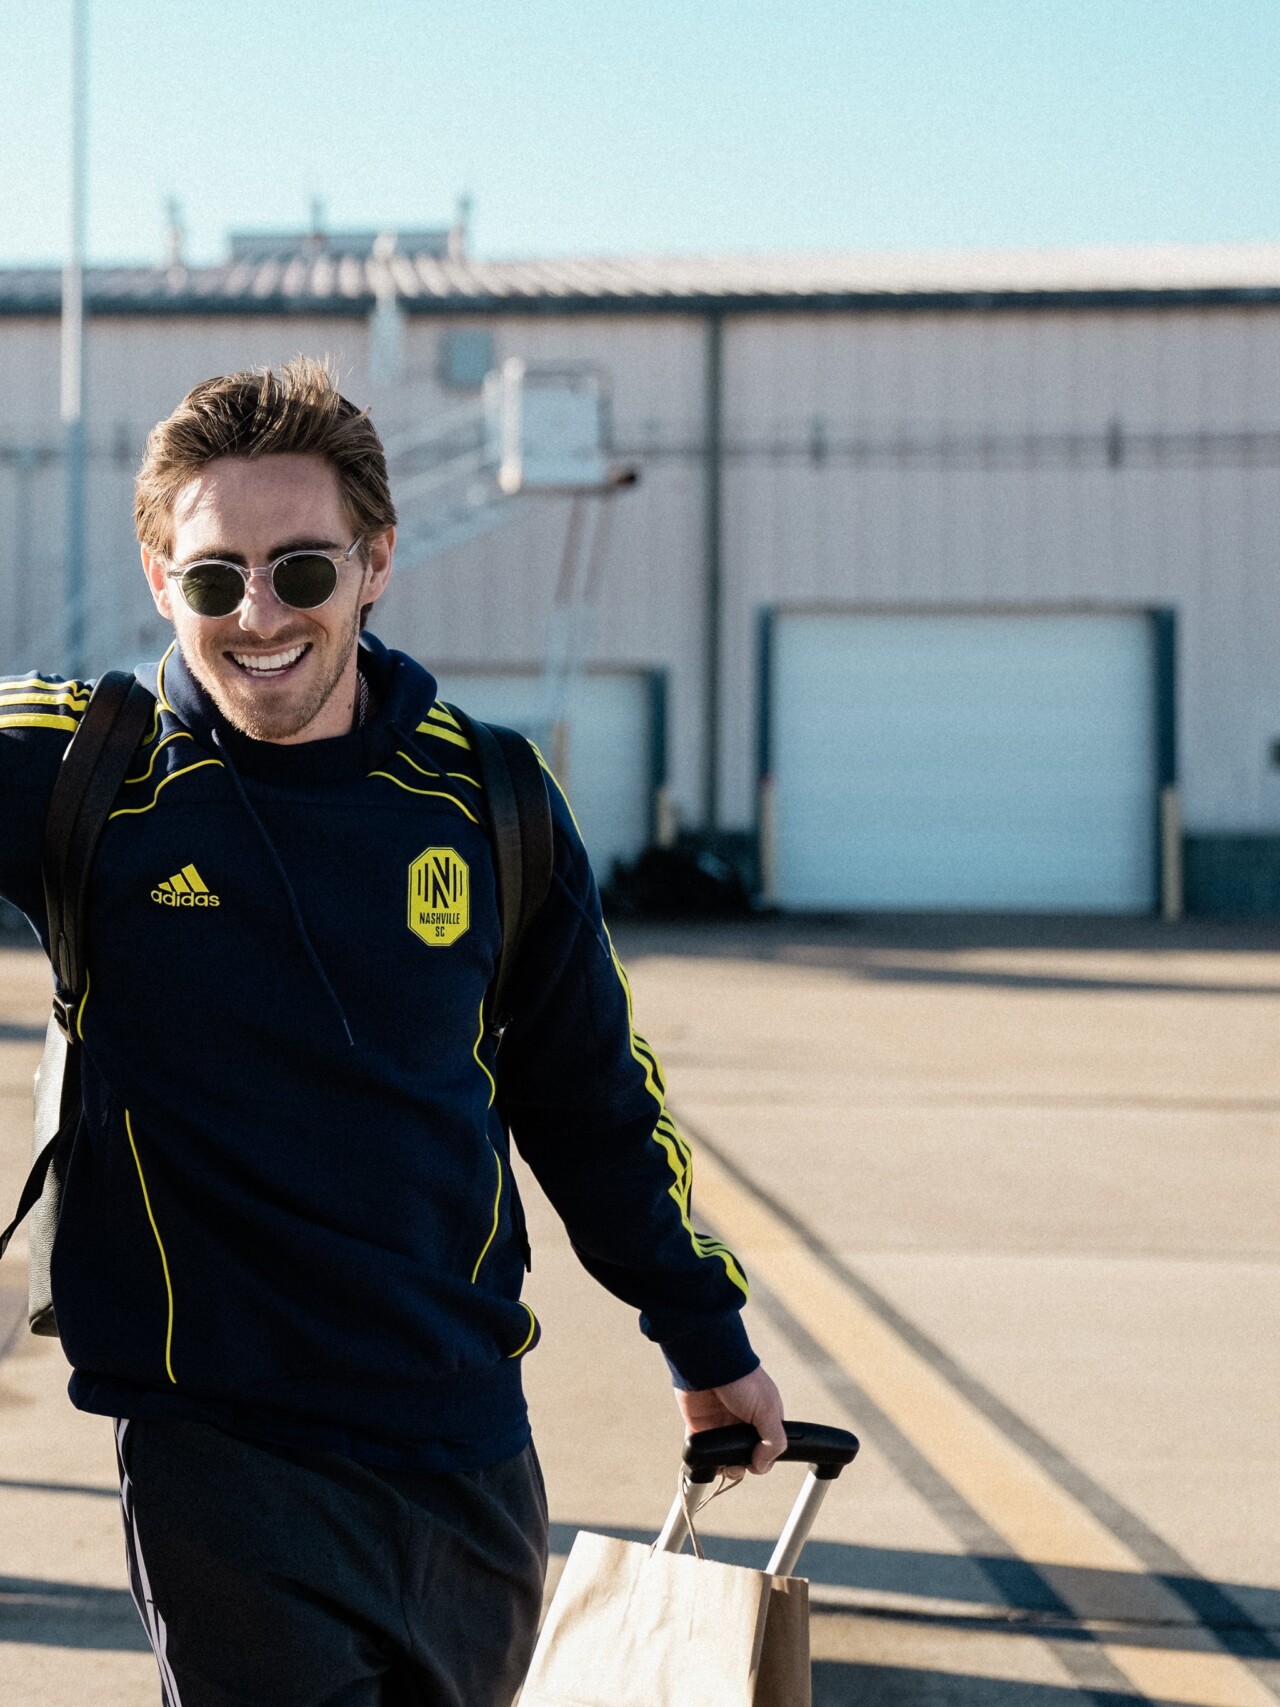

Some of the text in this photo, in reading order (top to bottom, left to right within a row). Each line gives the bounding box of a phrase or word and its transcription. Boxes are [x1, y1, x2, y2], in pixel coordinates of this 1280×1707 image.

[150, 890, 220, 907] adidas
[420, 912, 460, 925] NASHVILLE
[435, 926, 445, 937] SC
